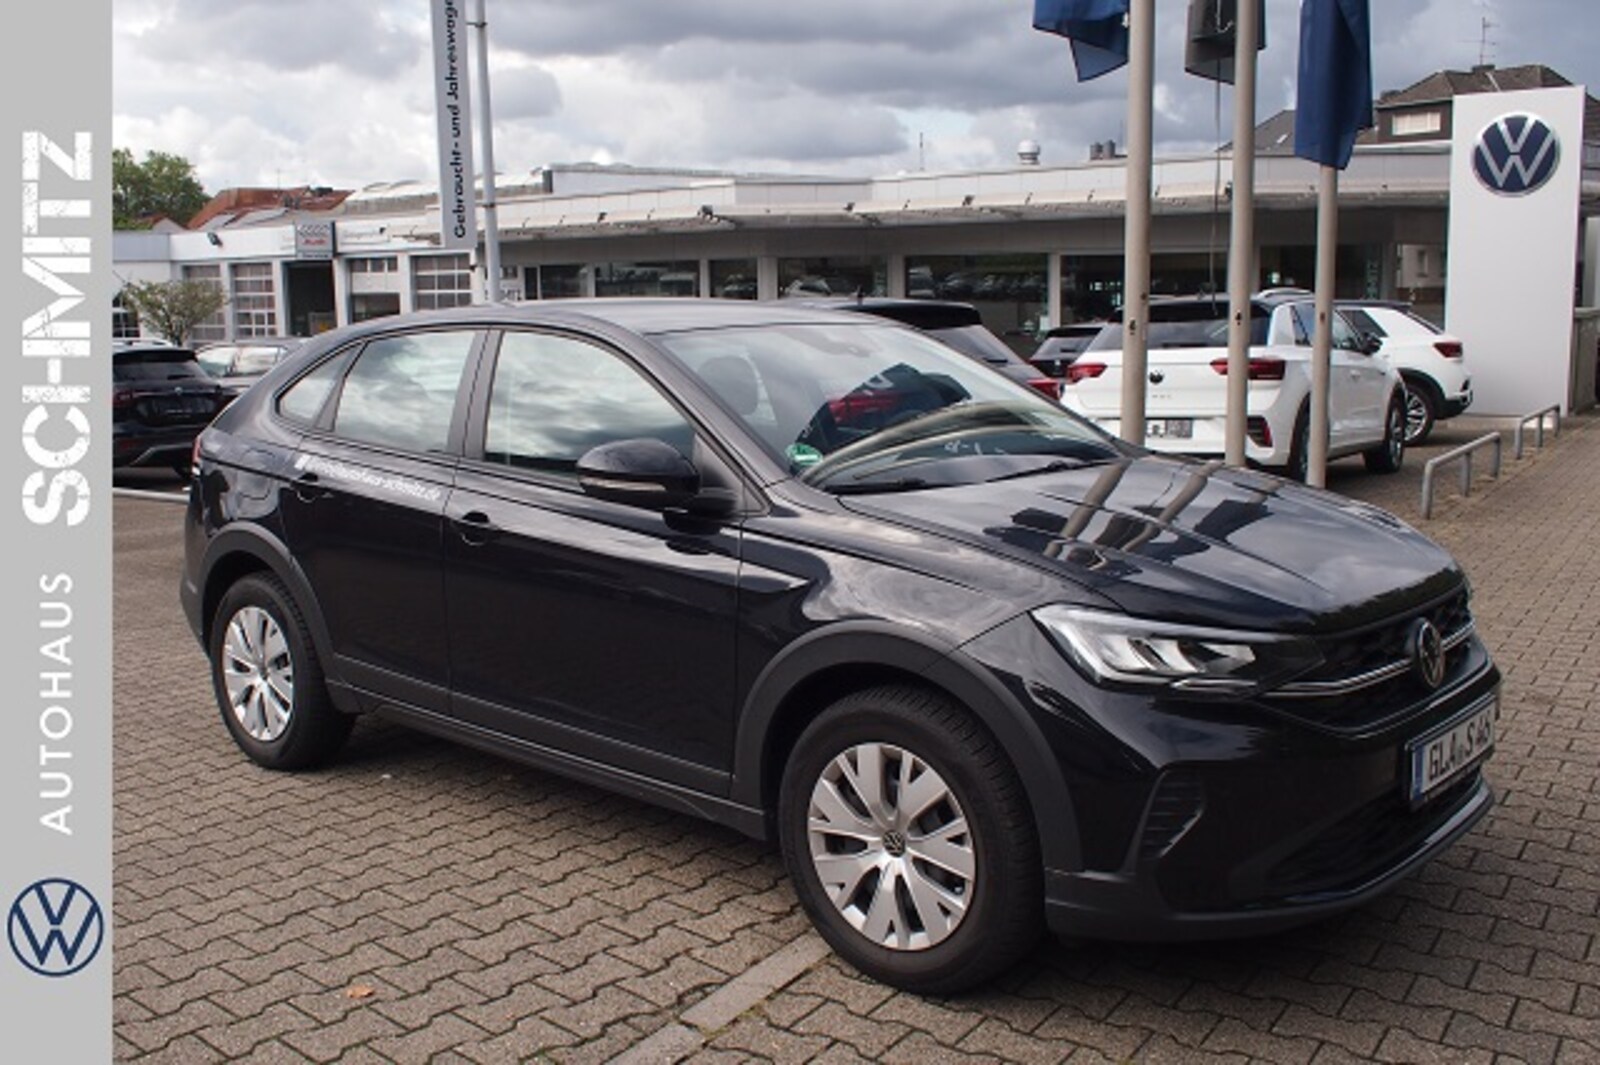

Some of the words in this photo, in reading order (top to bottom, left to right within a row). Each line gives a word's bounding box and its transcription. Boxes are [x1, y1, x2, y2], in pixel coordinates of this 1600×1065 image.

[446, 104, 462, 138] und
[1473, 113, 1560, 196] VW
[449, 141, 466, 239] Gebraucht-
